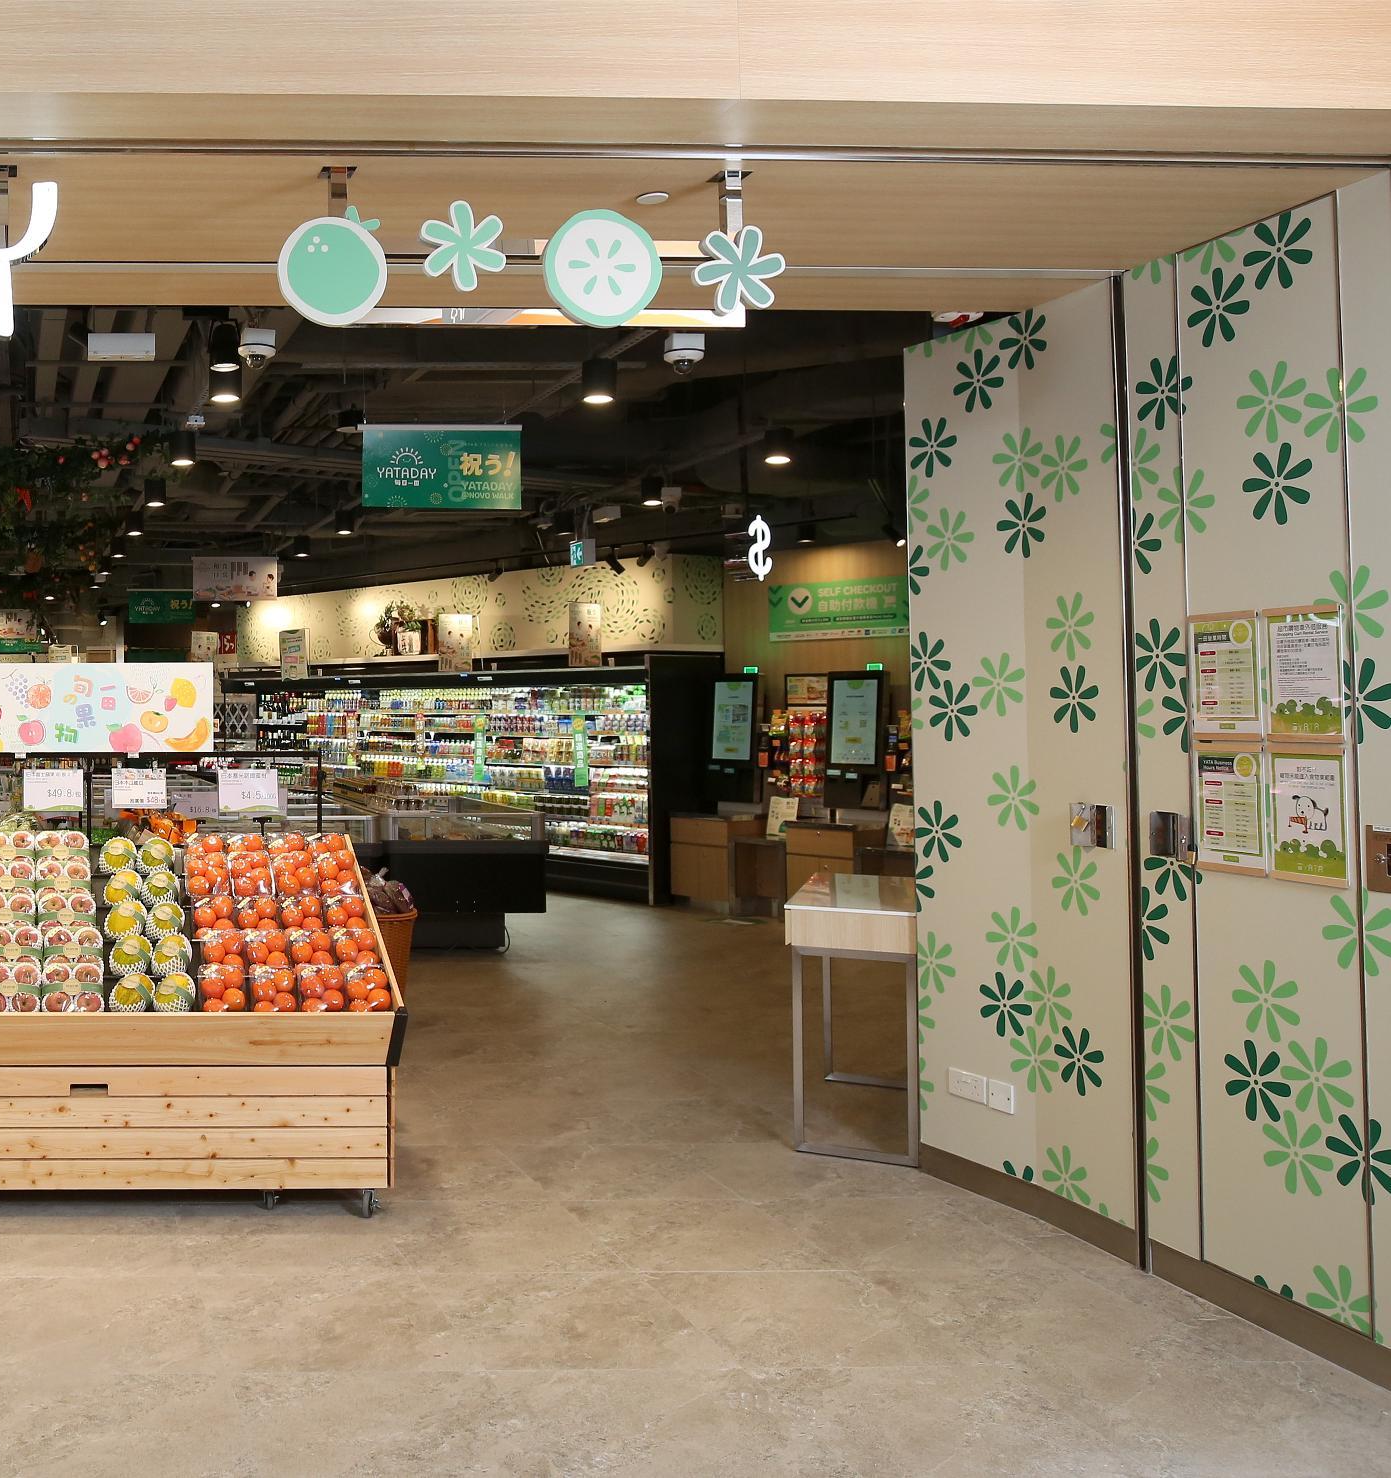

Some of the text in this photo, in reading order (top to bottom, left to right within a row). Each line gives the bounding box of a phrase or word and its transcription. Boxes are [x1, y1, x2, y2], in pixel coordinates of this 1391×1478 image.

[460, 450, 516, 477] 祝う!
[377, 466, 437, 480] YATADAY
[462, 481, 514, 491] YATADAY
[492, 491, 514, 500] WALK
[818, 583, 897, 597] SELF CHECKOUT
